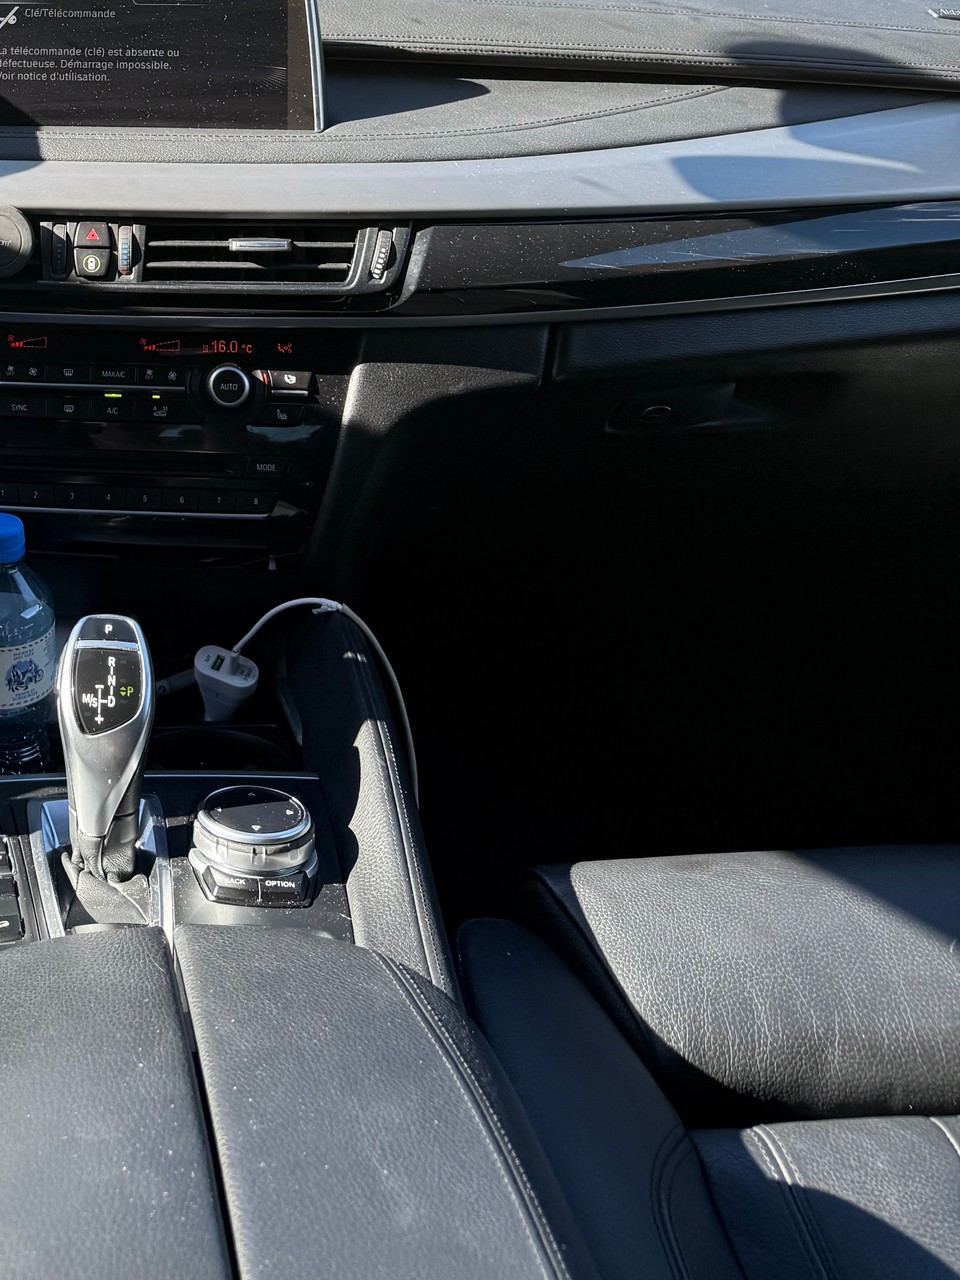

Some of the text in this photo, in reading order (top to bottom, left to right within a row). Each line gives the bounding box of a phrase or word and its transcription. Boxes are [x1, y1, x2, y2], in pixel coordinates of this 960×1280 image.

[24, 8, 116, 18] Clé/Télécommande
[10, 46, 82, 56] télécommande
[84, 47, 105, 58] (clé)
[108, 49, 123, 57] est
[125, 48, 165, 57] absente
[60, 59, 114, 70] Démarrage
[116, 60, 172, 71] impossible.
[17, 71, 47, 81] notice
[211, 340, 239, 353] 16.0
[220, 383, 238, 391] AUTO
[256, 463, 276, 471] MODE
[104, 624, 113, 634] P
[108, 656, 116, 667] R
[108, 675, 116, 686] N
[127, 686, 134, 697] P
[107, 695, 116, 708] D
[224, 878, 246, 886] BACK
[265, 880, 296, 889] OPTION
